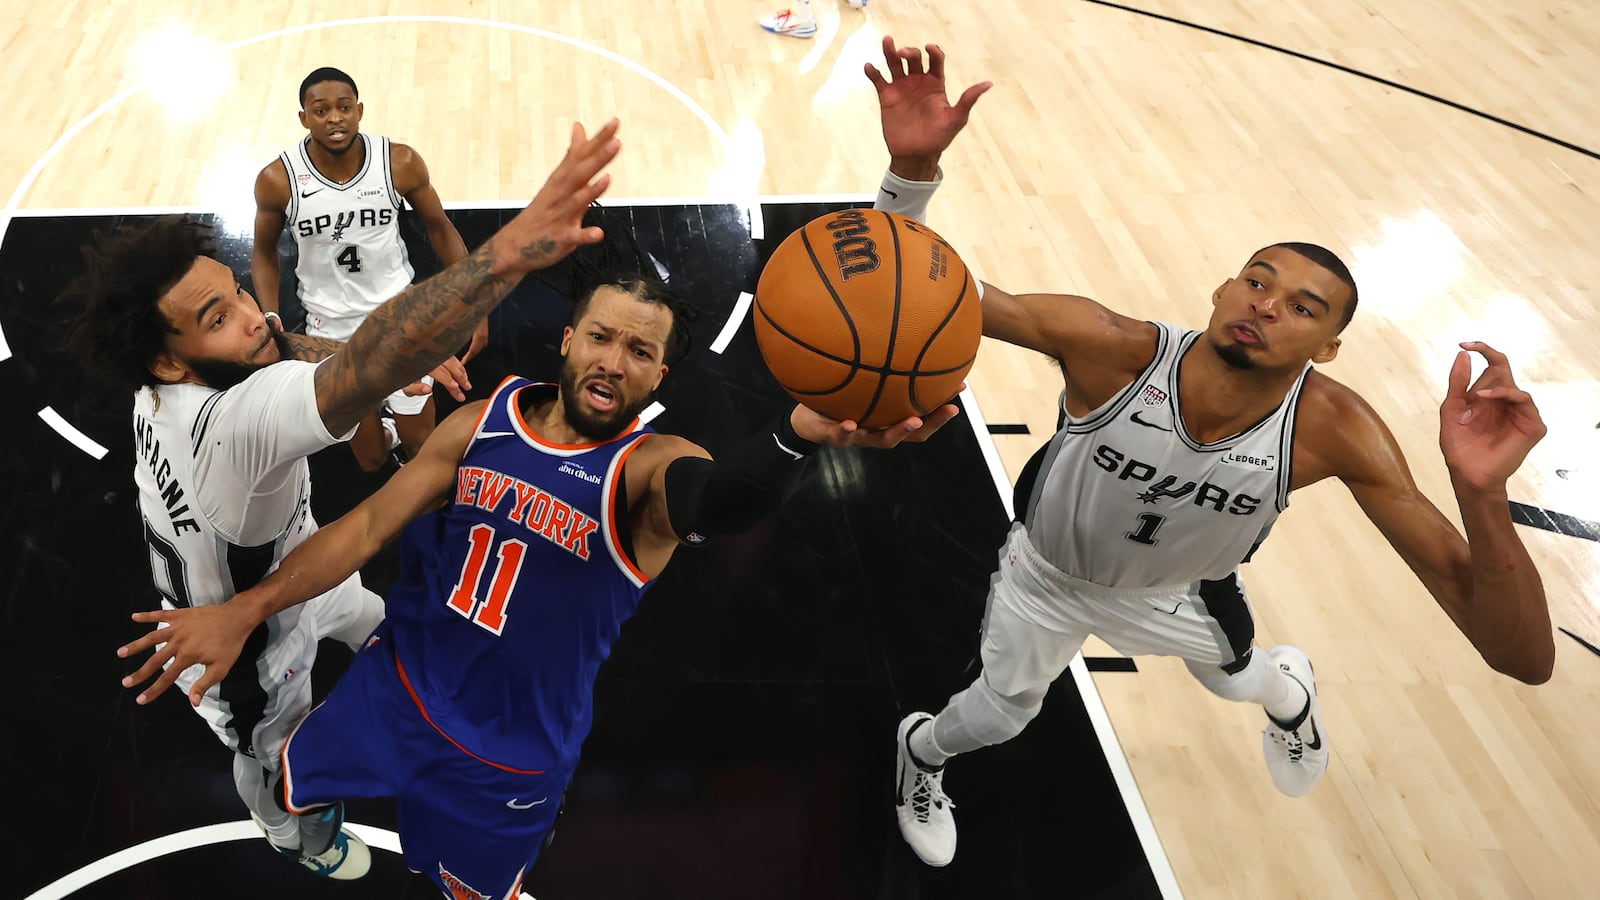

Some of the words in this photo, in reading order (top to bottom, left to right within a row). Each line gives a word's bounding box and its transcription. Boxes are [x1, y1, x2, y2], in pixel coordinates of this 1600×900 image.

[298, 208, 392, 241] SPURS
[825, 210, 881, 282] Wils
[335, 244, 362, 274] 4
[137, 414, 201, 537] MPAGNIE
[558, 464, 575, 476] abu
[574, 469, 602, 485] dhabi
[1093, 444, 1261, 515] SPURS
[1228, 452, 1268, 467] LEDGER
[455, 466, 513, 513] NEW
[508, 480, 600, 562] YORK
[1124, 511, 1168, 547] 1
[446, 522, 528, 637] 11
